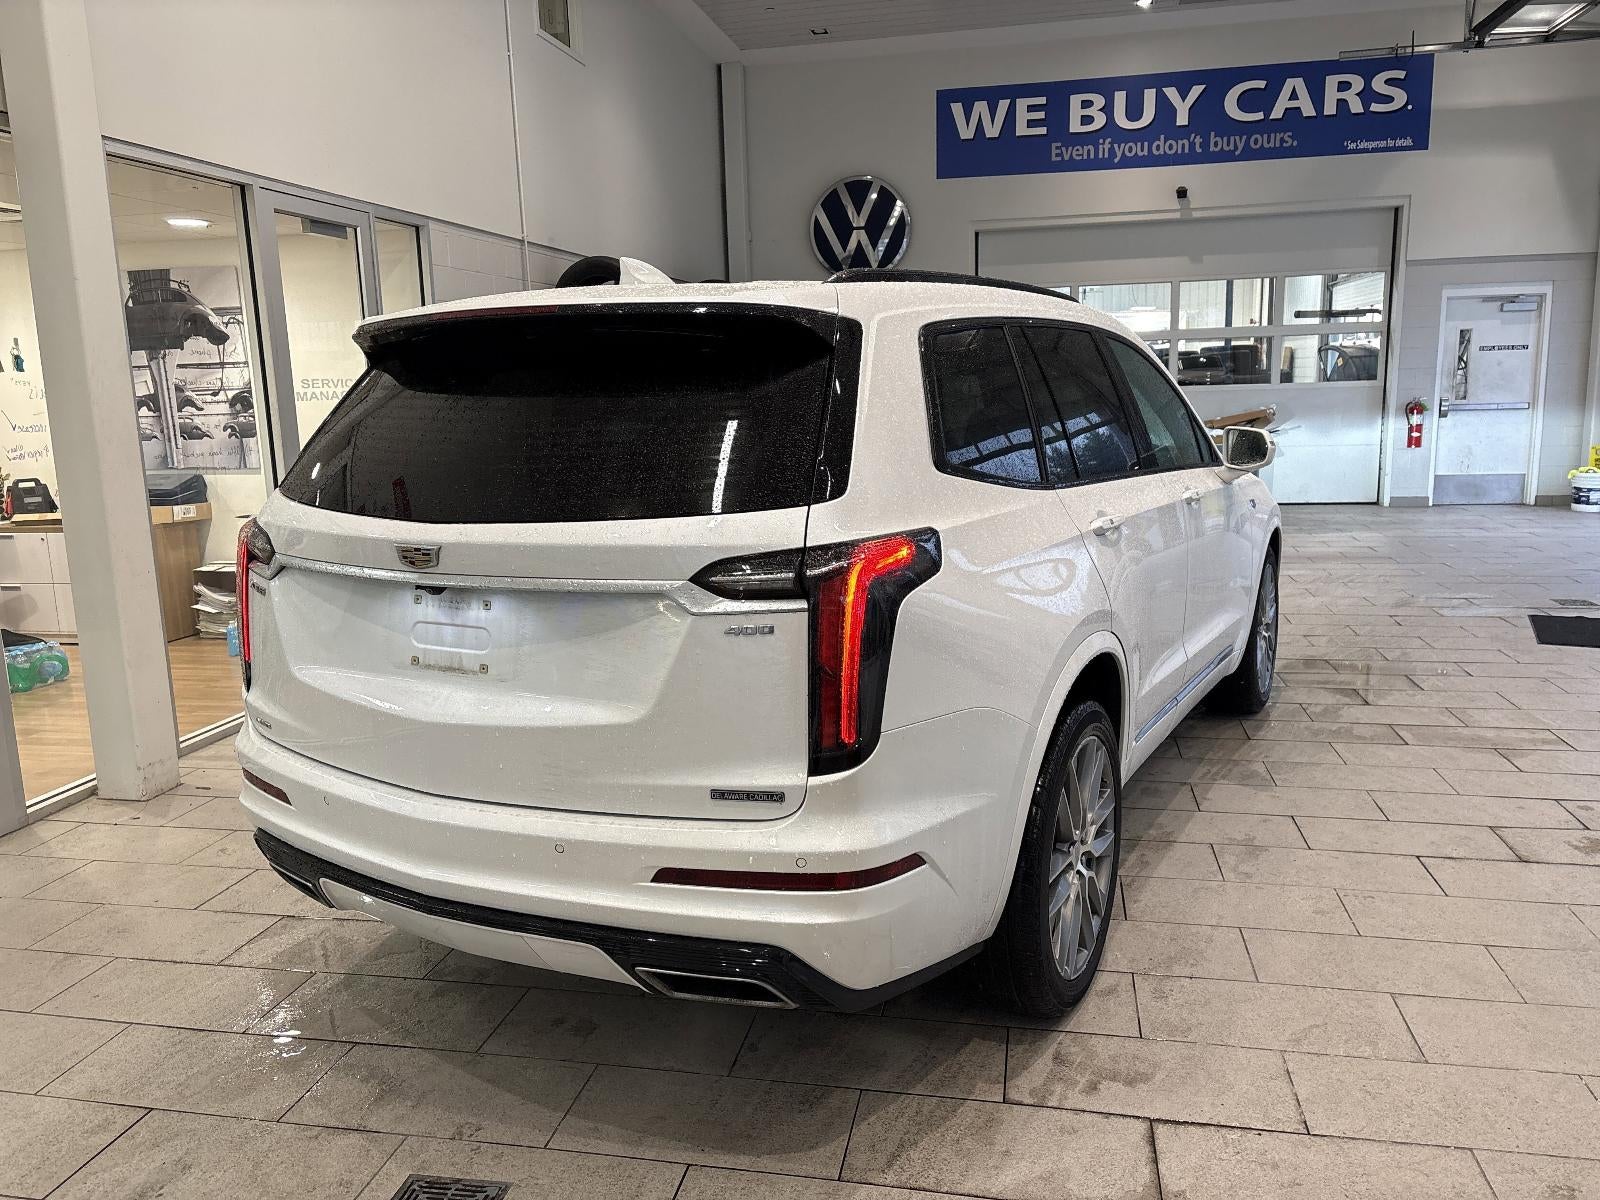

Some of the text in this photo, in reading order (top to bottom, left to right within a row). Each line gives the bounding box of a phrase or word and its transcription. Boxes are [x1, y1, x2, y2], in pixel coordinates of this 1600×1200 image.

[950, 70, 1413, 140] WE BUY CARS.
[1051, 131, 1298, 163] Even if you don’t buy ours.
[1357, 139, 1387, 150] Salesperson
[1387, 138, 1395, 147] for
[300, 378, 354, 389] SERVIC
[296, 391, 345, 401] MANA
[724, 624, 774, 636] 400
